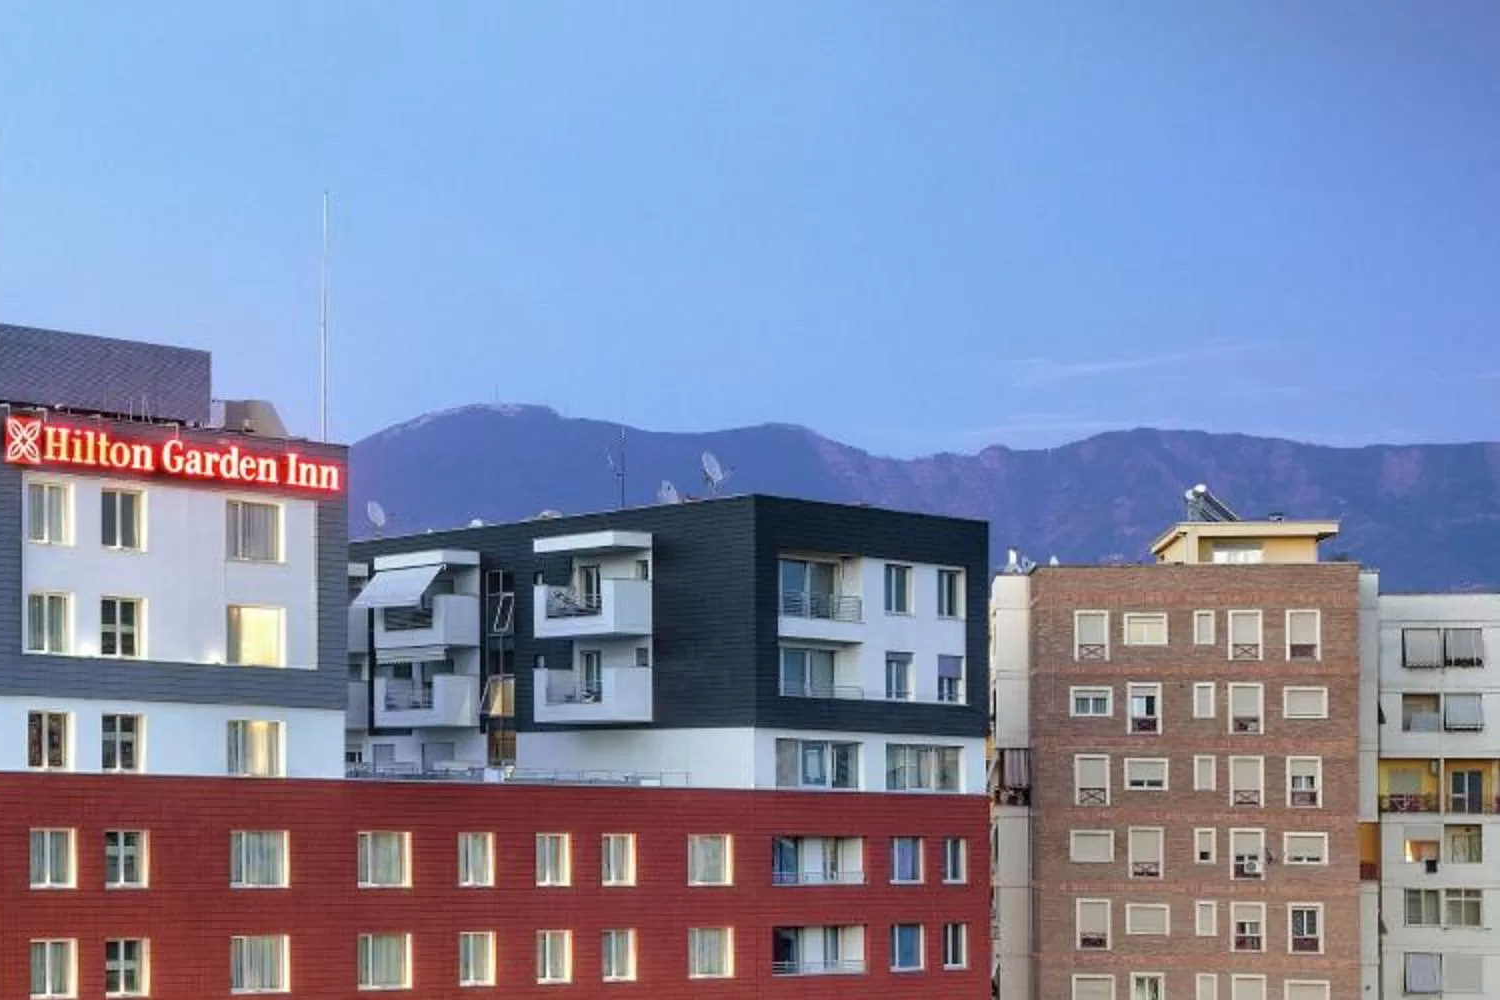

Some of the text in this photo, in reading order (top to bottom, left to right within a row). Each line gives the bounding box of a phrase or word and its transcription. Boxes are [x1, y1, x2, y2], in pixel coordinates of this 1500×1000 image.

[43, 426, 340, 491] Hilton Garden Inn
